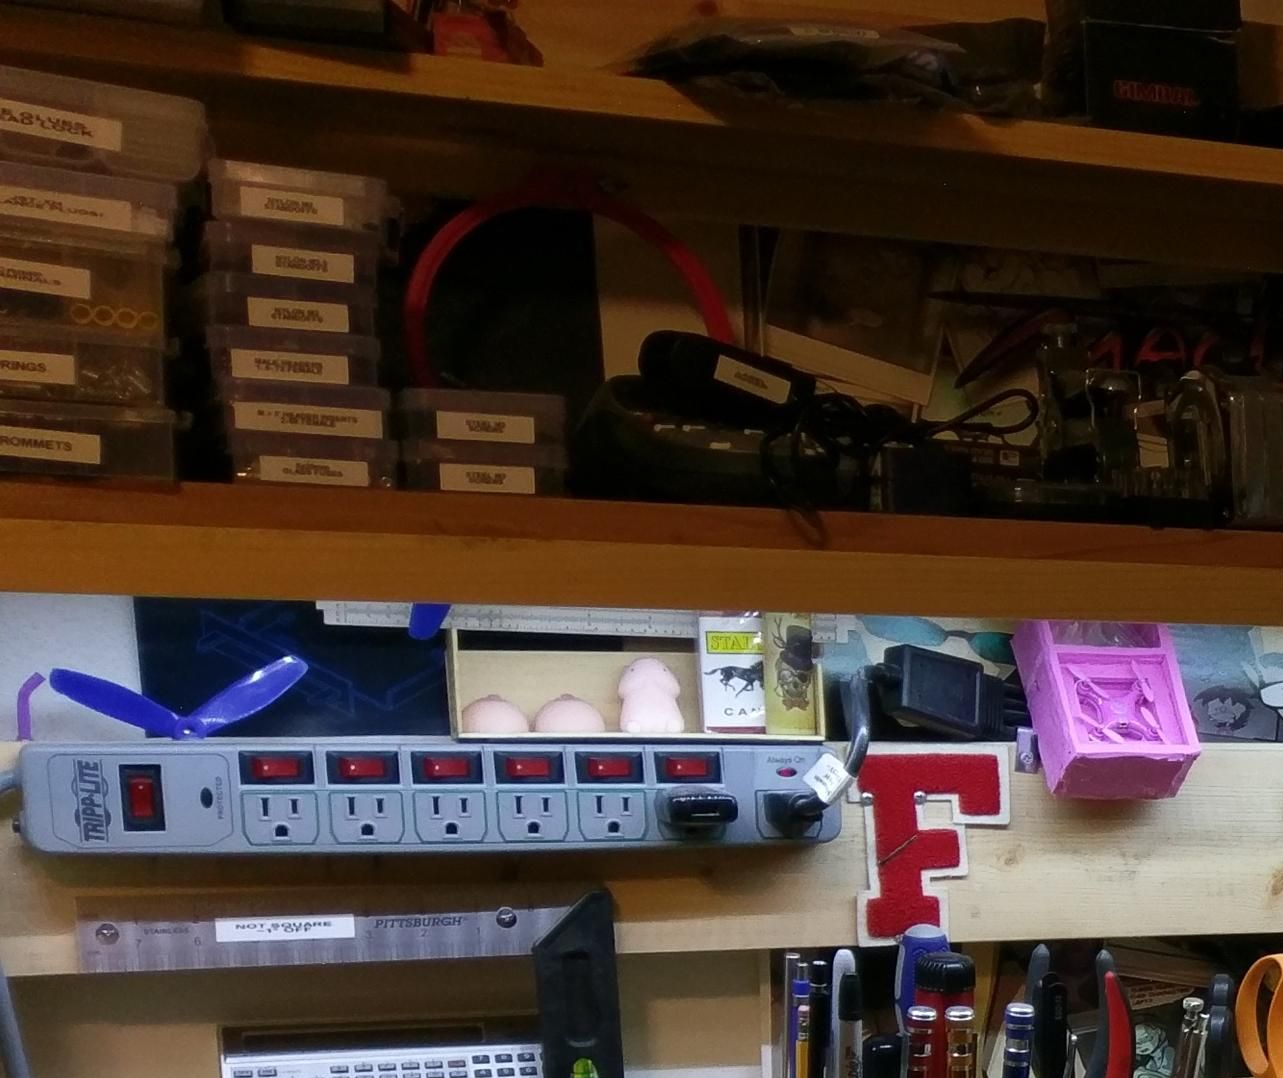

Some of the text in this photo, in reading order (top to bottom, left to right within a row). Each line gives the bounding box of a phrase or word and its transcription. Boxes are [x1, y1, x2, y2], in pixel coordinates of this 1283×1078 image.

[766, 755, 793, 764] Always
[235, 919, 333, 931] NOT SQUARE
[374, 916, 464, 929] PITTSBURGH
